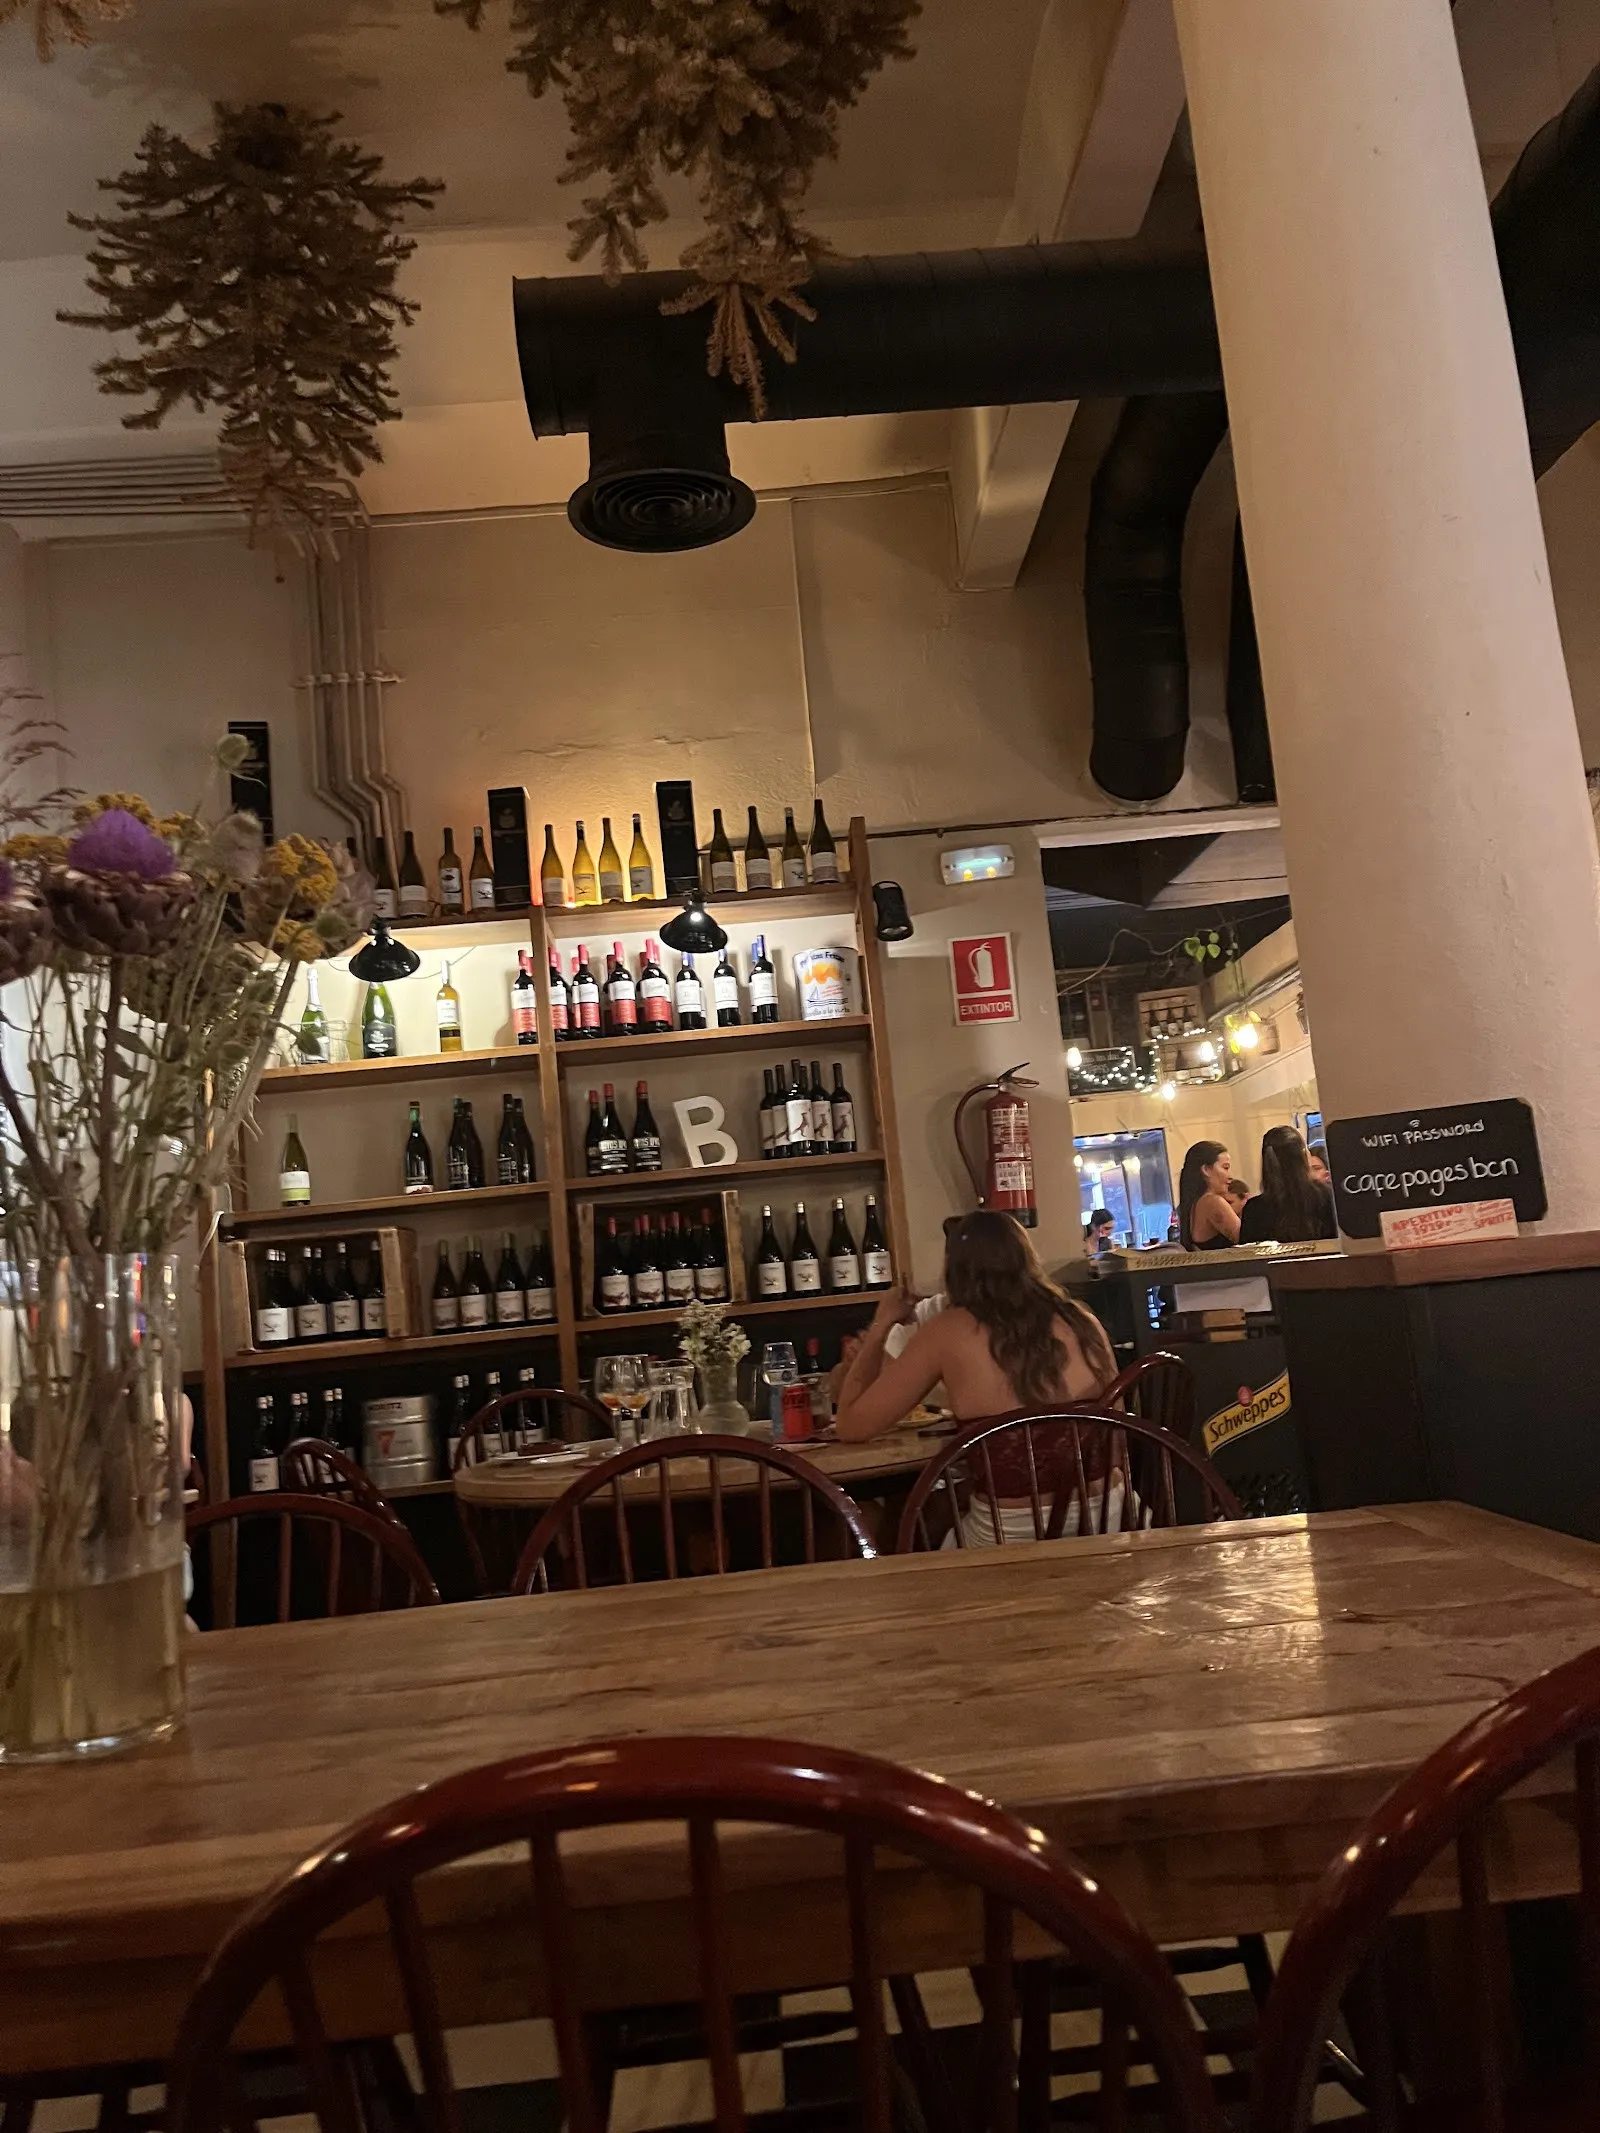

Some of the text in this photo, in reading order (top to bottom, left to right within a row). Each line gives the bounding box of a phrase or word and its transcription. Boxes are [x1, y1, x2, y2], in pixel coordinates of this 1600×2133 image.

[961, 1001, 1012, 1016] EXTINTOR
[672, 1095, 738, 1169] B
[1362, 1118, 1485, 1148] WIFI PASSWORD
[1208, 1386, 1288, 1444] Schweppes
